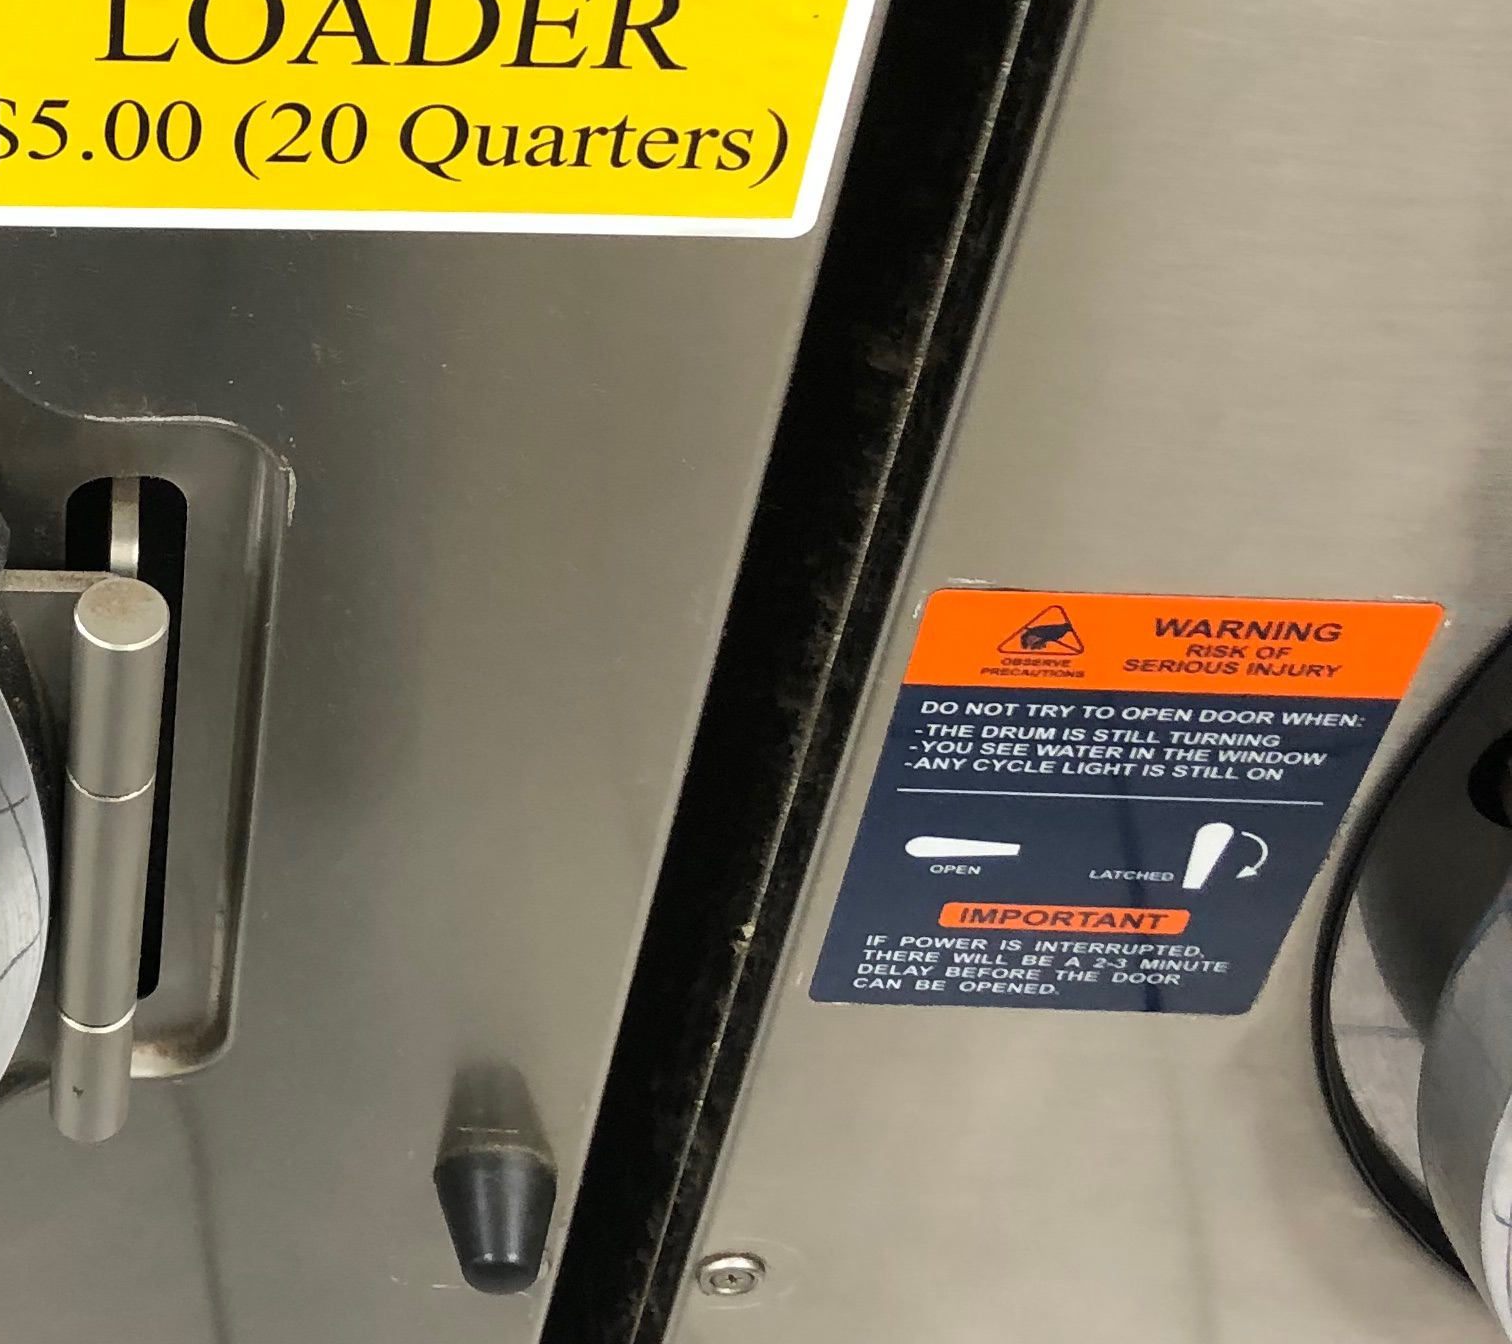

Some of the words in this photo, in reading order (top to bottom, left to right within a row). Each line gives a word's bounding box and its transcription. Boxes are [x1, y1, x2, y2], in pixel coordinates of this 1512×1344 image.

[233, 100, 368, 181] (20
[399, 103, 789, 189] Quarters)
[1154, 617, 1343, 643] WARNING
[1000, 657, 1071, 668] OBSERVE
[1185, 643, 1246, 659] RISK
[1255, 646, 1293, 661] OF
[980, 667, 1086, 679] PRECAUTIONS
[1122, 658, 1239, 675] SERIOUS
[1246, 662, 1342, 678] INJURY
[920, 700, 959, 715] DO
[964, 702, 1019, 717] NOT
[1026, 703, 1076, 719] TRY
[1082, 705, 1115, 720] TO
[1121, 706, 1193, 723] OPEN
[1198, 709, 1275, 725] DOOR
[1281, 712, 1365, 728] WHEN:
[981, 725, 1057, 741] DRUM
[1061, 727, 1087, 742] IS
[1092, 728, 1161, 744] STILL
[1169, 731, 1281, 748] TURNING
[979, 742, 1030, 757] SEE
[1037, 743, 1125, 760] WATER
[1129, 746, 1156, 760] IN
[1162, 747, 1212, 763] THE
[1218, 749, 1328, 766] WINDOW
[972, 758, 1057, 774] CYCLE
[1061, 761, 1138, 777] LIGHT
[1141, 763, 1166, 778] IS
[1171, 764, 1239, 780] STILL
[1246, 767, 1285, 781] ON
[929, 863, 982, 876] OPEN
[1088, 868, 1175, 882] LATCHED
[958, 907, 1170, 931] IMPORTANT
[865, 934, 889, 947] IF
[899, 935, 989, 951] POWER
[999, 938, 1023, 952] IS
[862, 949, 941, 963] THERE
[952, 952, 1009, 966] WILL
[1021, 954, 1055, 967] BE
[1064, 956, 1081, 969] A
[1092, 957, 1129, 969] 2-3
[1139, 958, 1231, 973] MINUTE
[852, 977, 903, 991] CAN
[914, 979, 948, 992] BE
[857, 963, 935, 977] DELAY
[944, 965, 1042, 980] BEFORE
[1055, 969, 1101, 983] THE
[1111, 971, 1182, 986] DOOR
